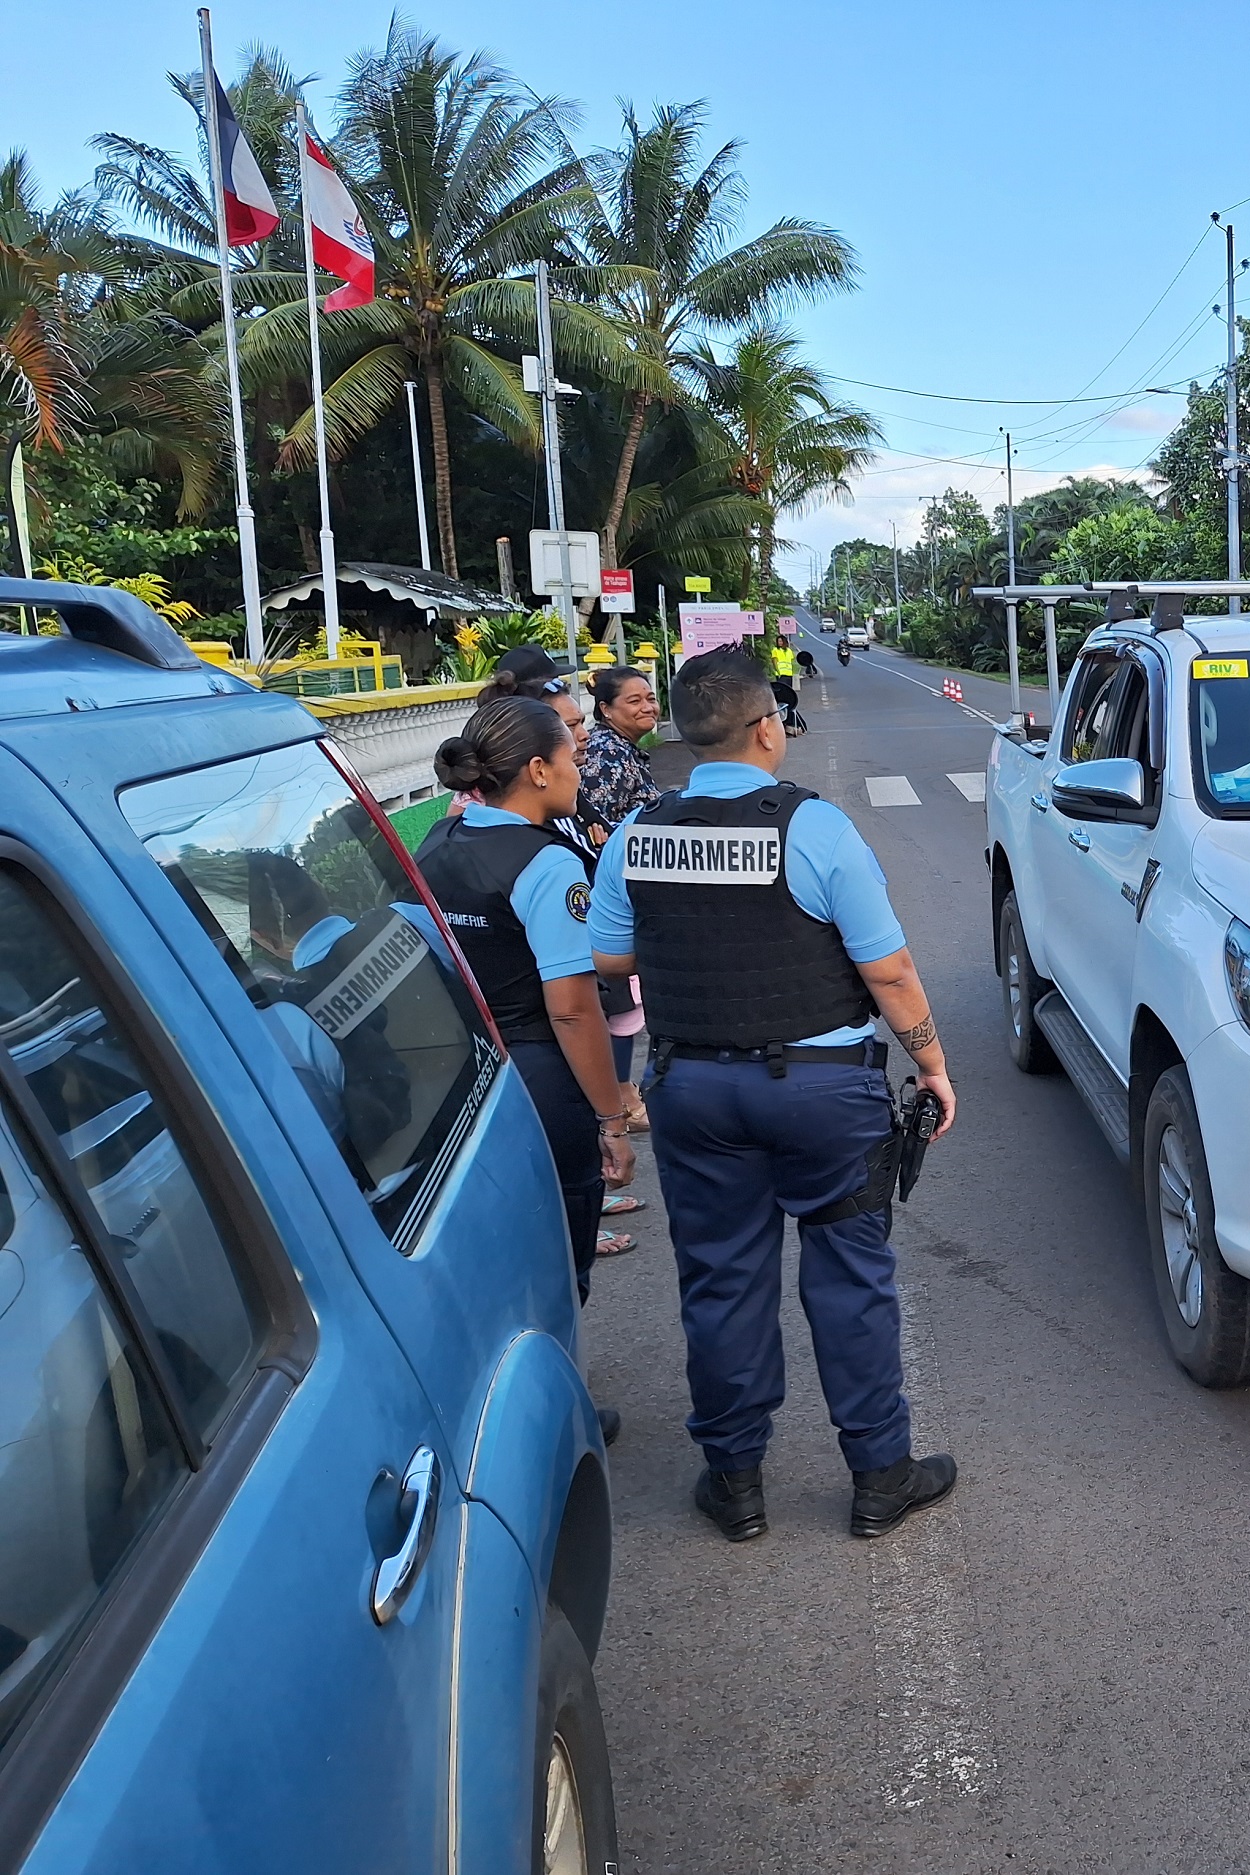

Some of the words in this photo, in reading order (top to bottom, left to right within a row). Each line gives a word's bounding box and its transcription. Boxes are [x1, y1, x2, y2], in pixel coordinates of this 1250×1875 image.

[1209, 664, 1233, 673] RIV
[627, 835, 778, 872] GENDARMERIE
[466, 1053, 496, 1117] EVEREST
